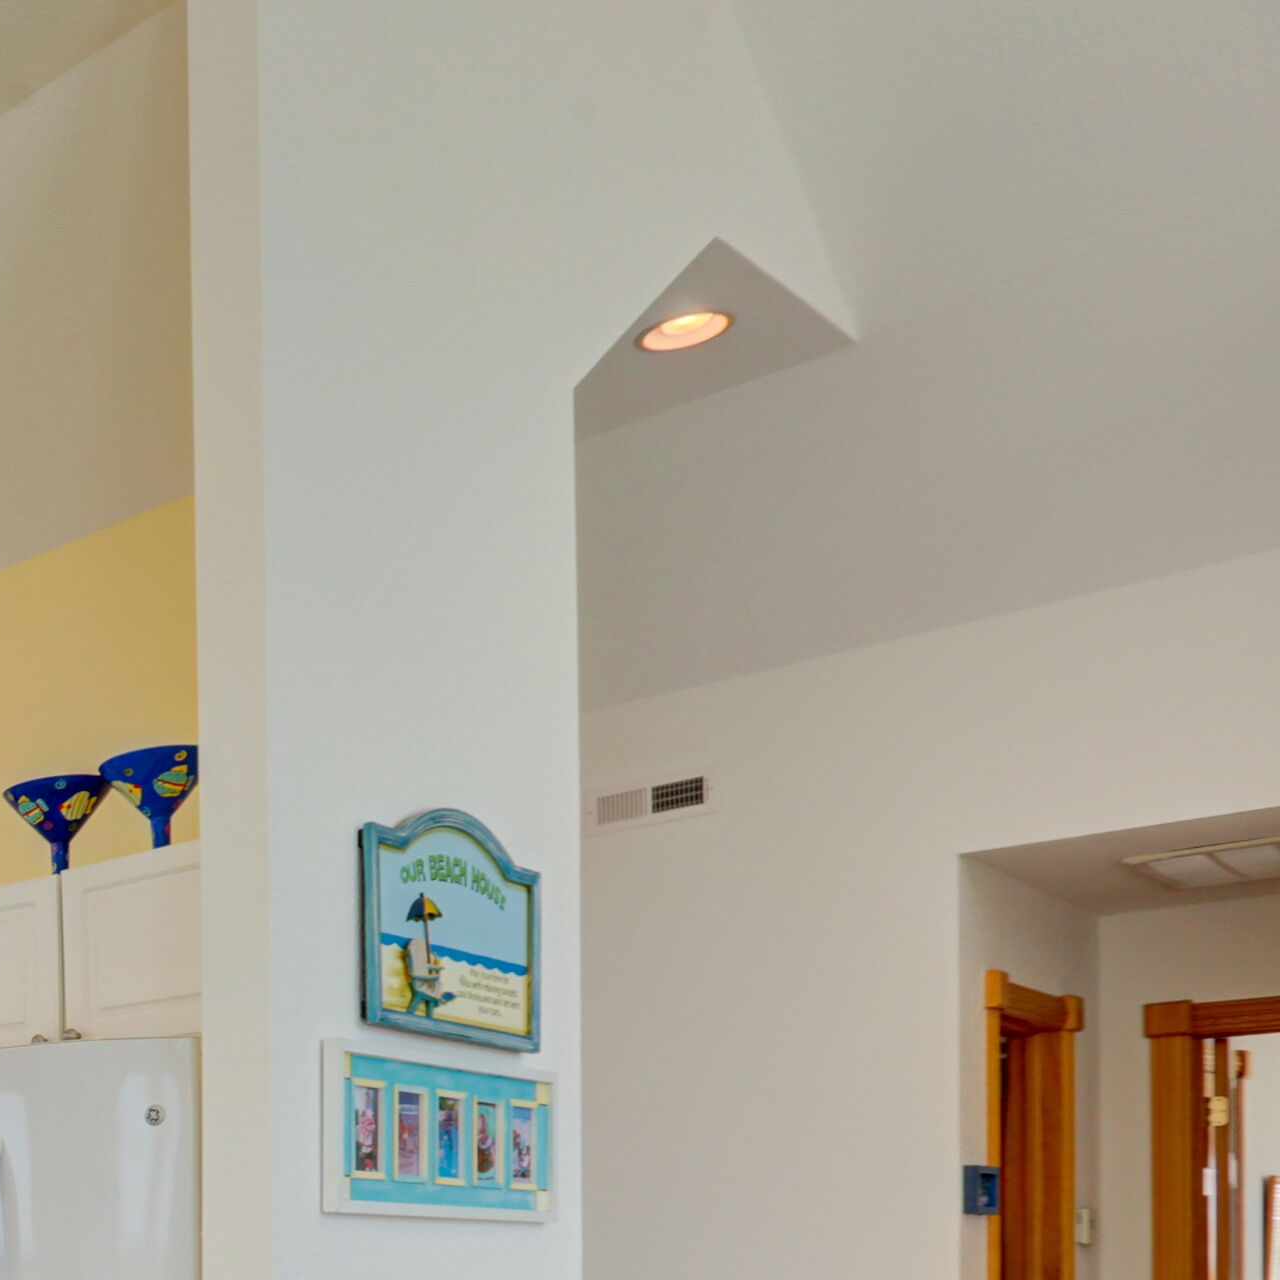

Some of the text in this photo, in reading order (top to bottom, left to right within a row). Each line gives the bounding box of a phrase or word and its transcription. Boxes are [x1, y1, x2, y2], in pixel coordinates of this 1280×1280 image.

[400, 854, 507, 911] OUR BEACH HOUSE
